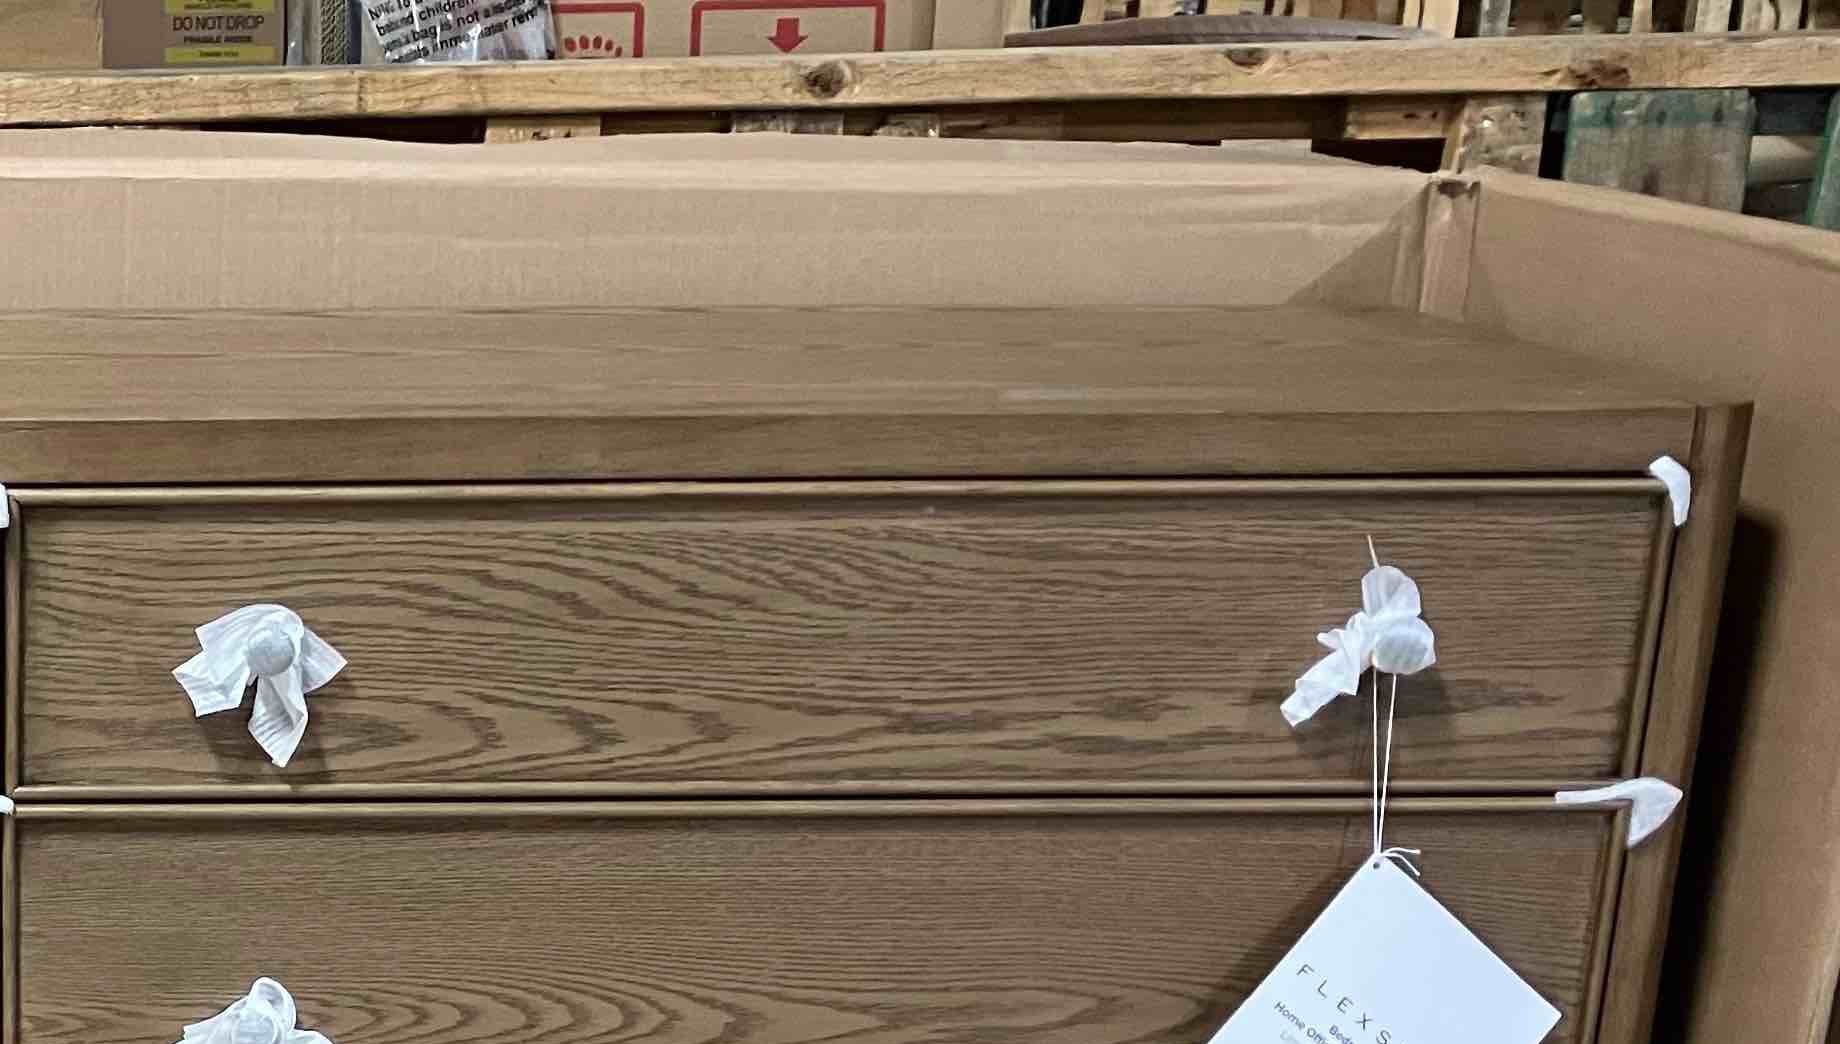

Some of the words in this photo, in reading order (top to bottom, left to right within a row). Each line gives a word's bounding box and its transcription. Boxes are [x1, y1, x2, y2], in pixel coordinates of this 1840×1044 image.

[172, 15, 193, 31] DO
[194, 15, 223, 31] NOT
[225, 14, 265, 31] DROP
[457, 10, 481, 27] not
[1273, 1001, 1306, 1031] Home
